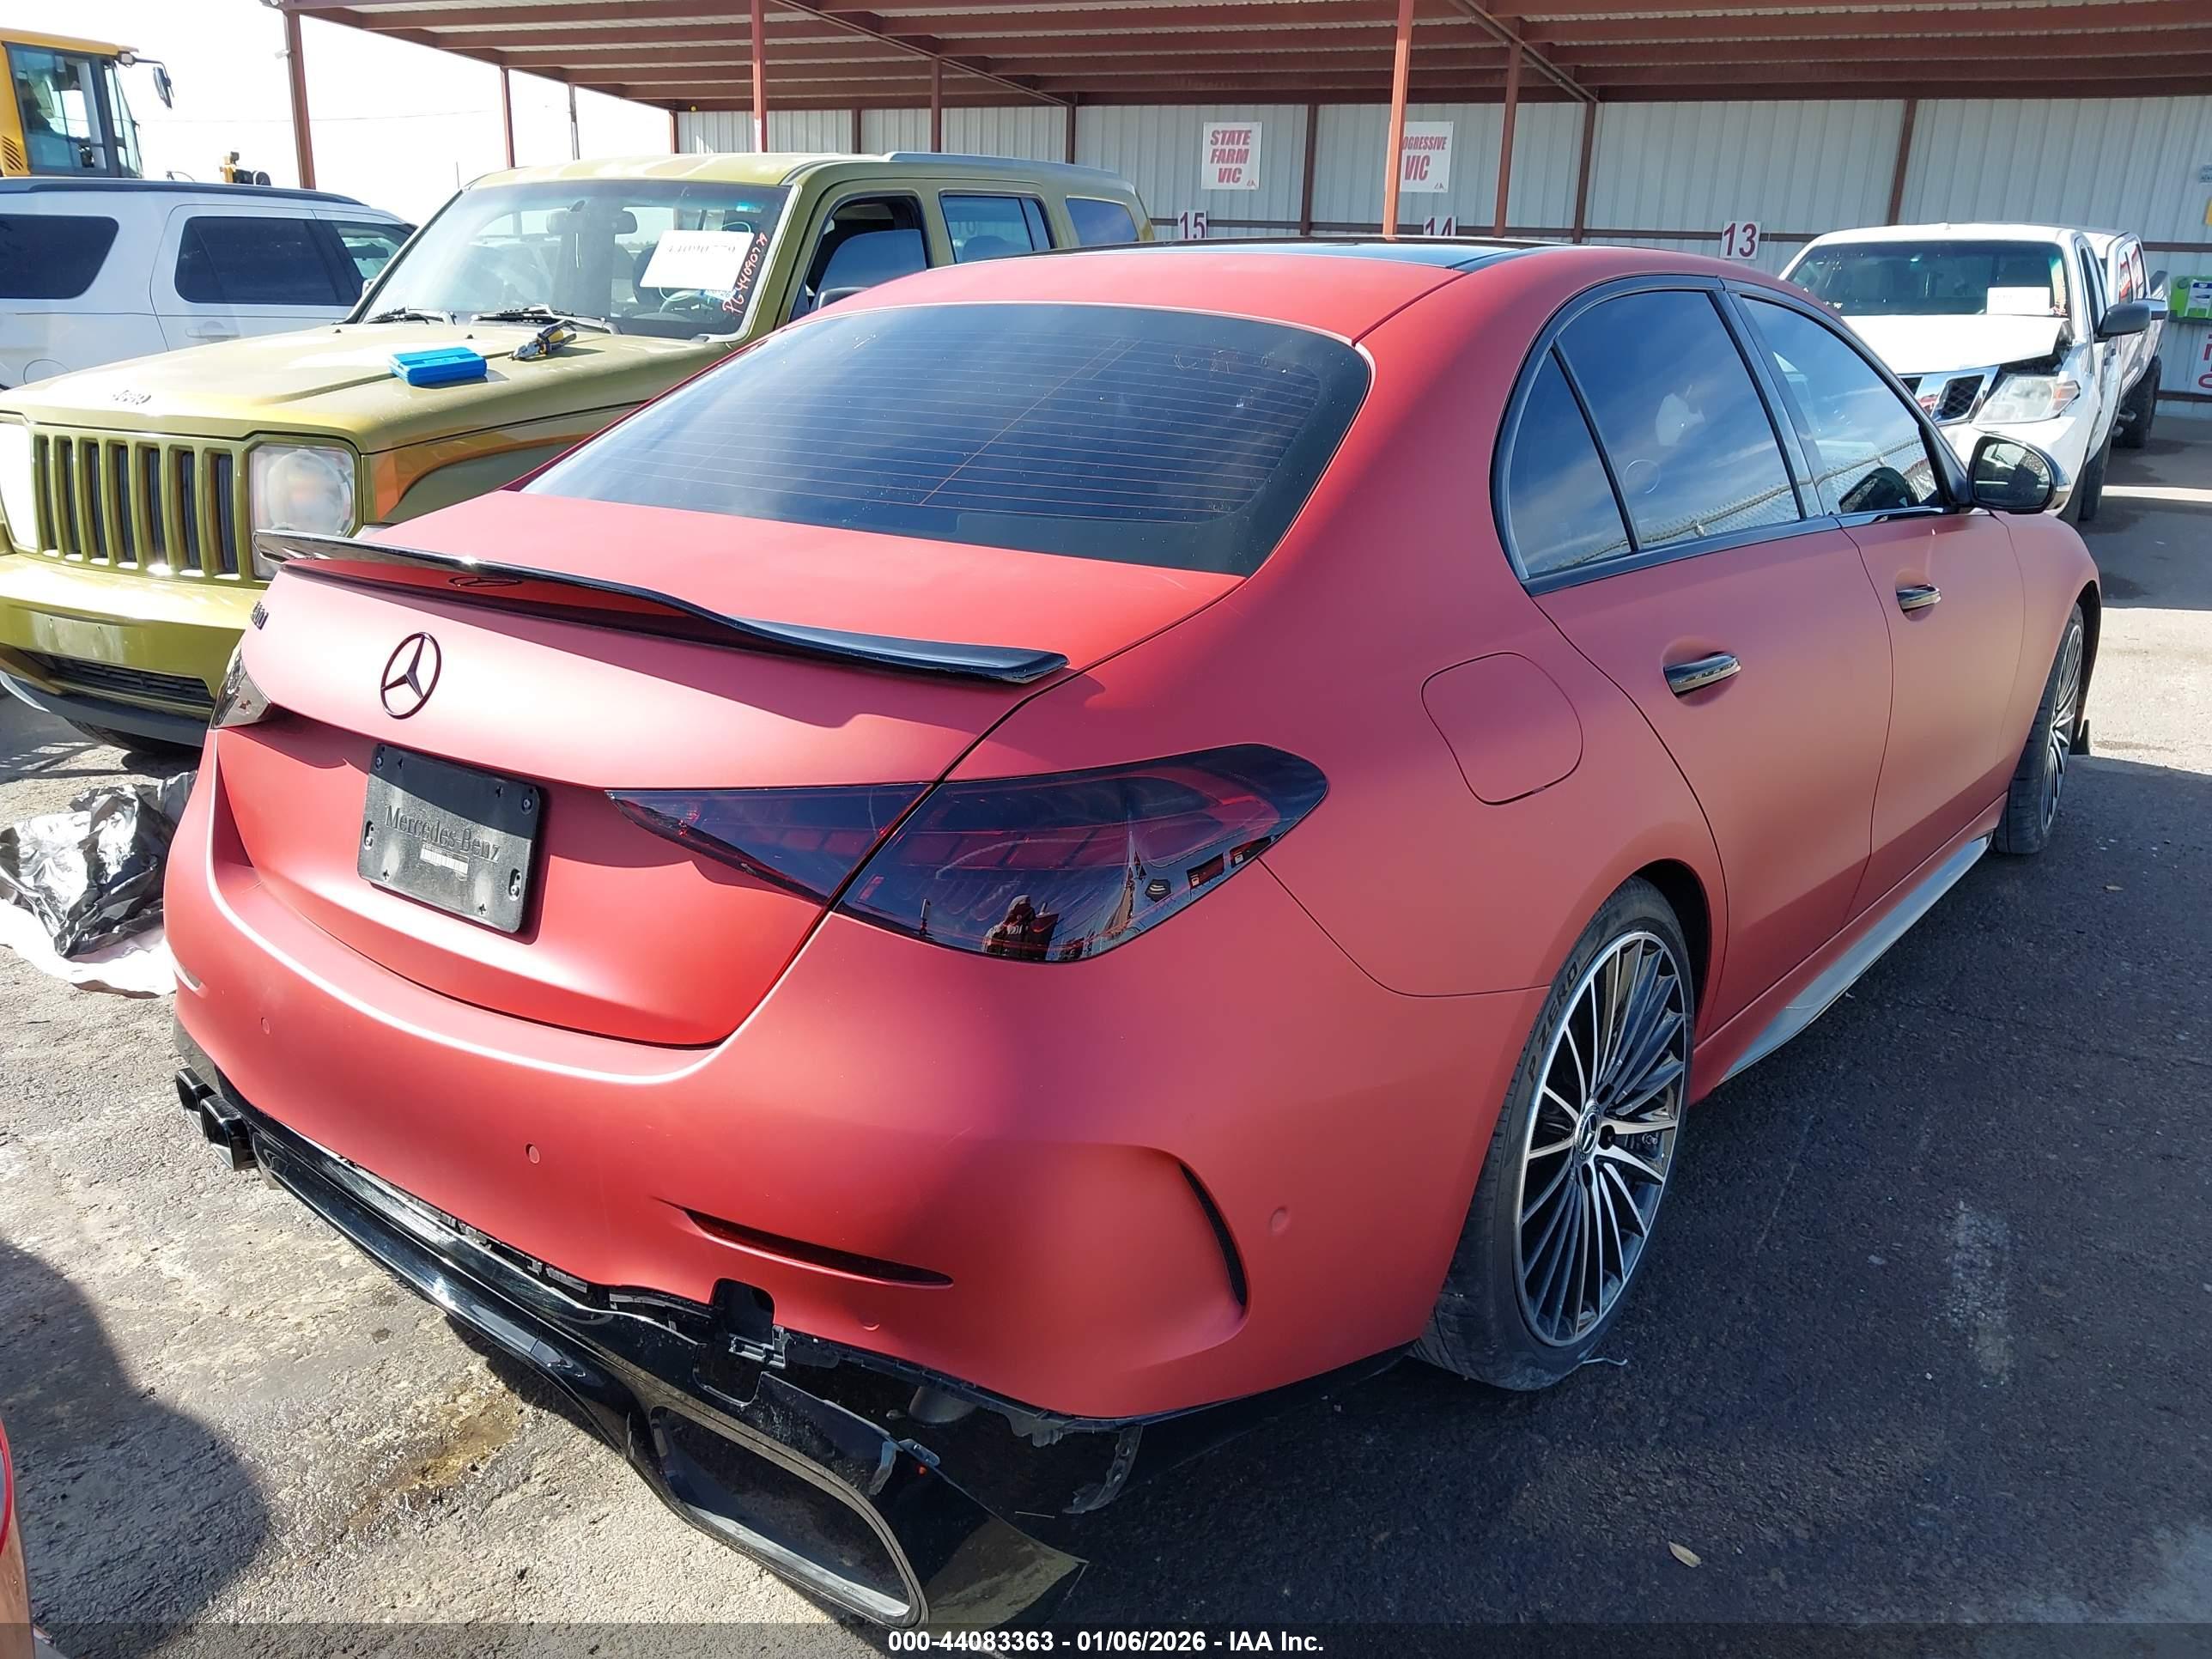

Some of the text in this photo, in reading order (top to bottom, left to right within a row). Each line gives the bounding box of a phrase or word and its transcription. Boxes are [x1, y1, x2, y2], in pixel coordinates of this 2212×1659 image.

[1210, 130, 1252, 146] STATE
[1402, 136, 1448, 150] OGRESSIVE
[1210, 149, 1249, 164] FARM
[1218, 167, 1243, 184] VIC
[1404, 155, 1431, 181] VIC
[1180, 211, 1206, 240] 15
[1425, 216, 1453, 237] 14
[1723, 222, 1757, 258] 13
[385, 804, 501, 864] Mercedes-Benz
